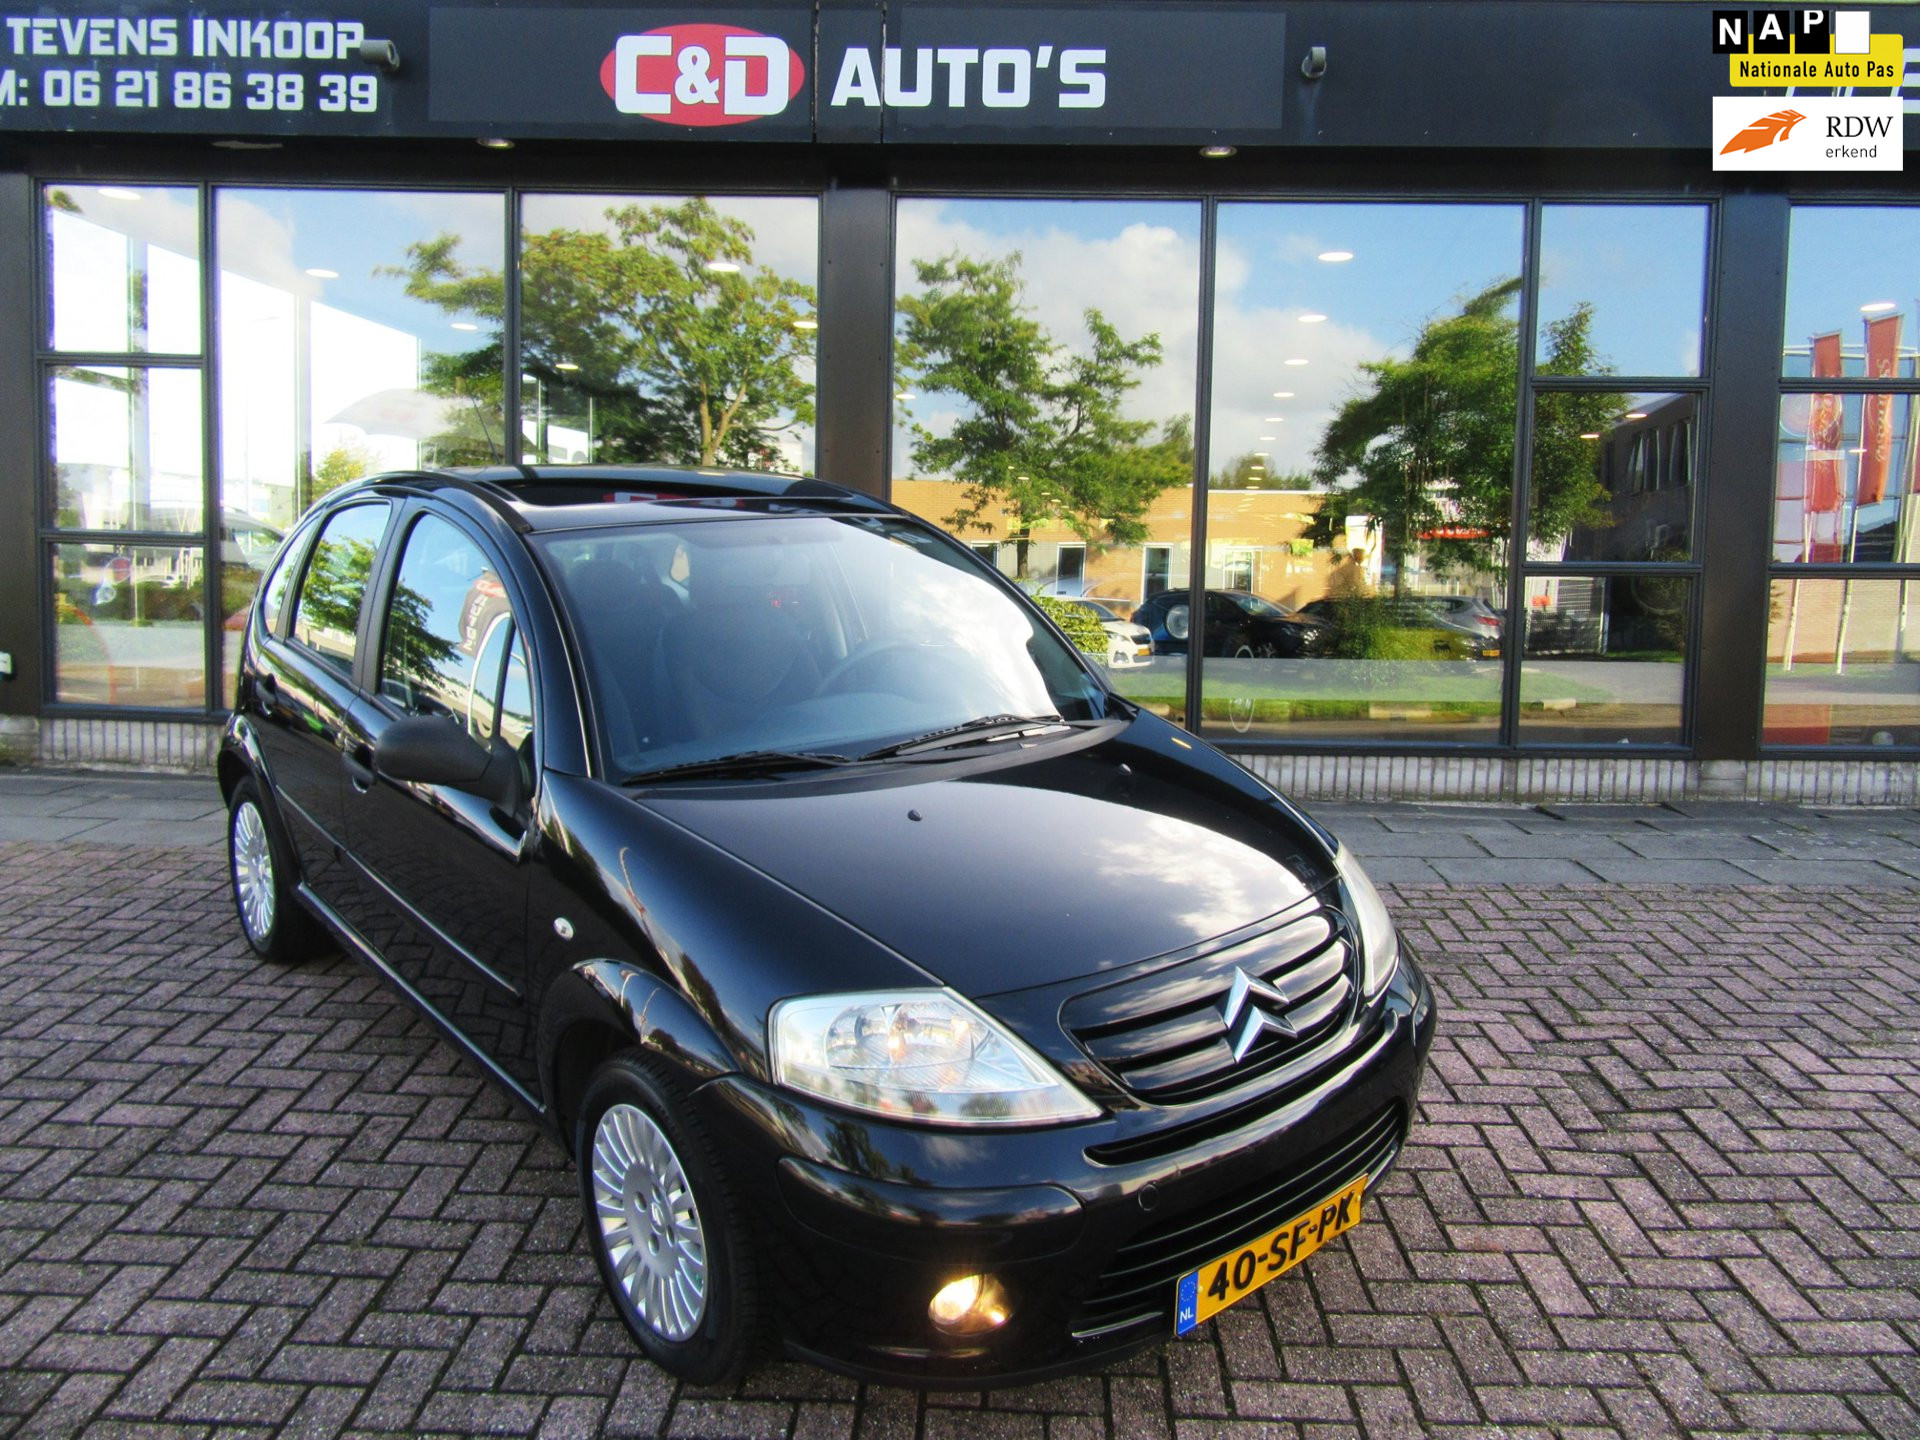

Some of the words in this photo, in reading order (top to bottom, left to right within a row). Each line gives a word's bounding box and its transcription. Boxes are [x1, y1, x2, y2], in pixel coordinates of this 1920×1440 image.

[6, 17, 178, 56] TEVENS
[192, 19, 364, 59] INKOOP
[43, 69, 101, 107] 06
[115, 70, 159, 108] 21
[173, 71, 232, 109] 86
[246, 72, 304, 111] 38
[319, 74, 378, 113] 39
[615, 35, 790, 116] C&D
[830, 45, 1107, 109] AUTO'S
[1207, 1191, 1355, 1301] 40-SF-PK
[1179, 1306, 1195, 1324] NL
